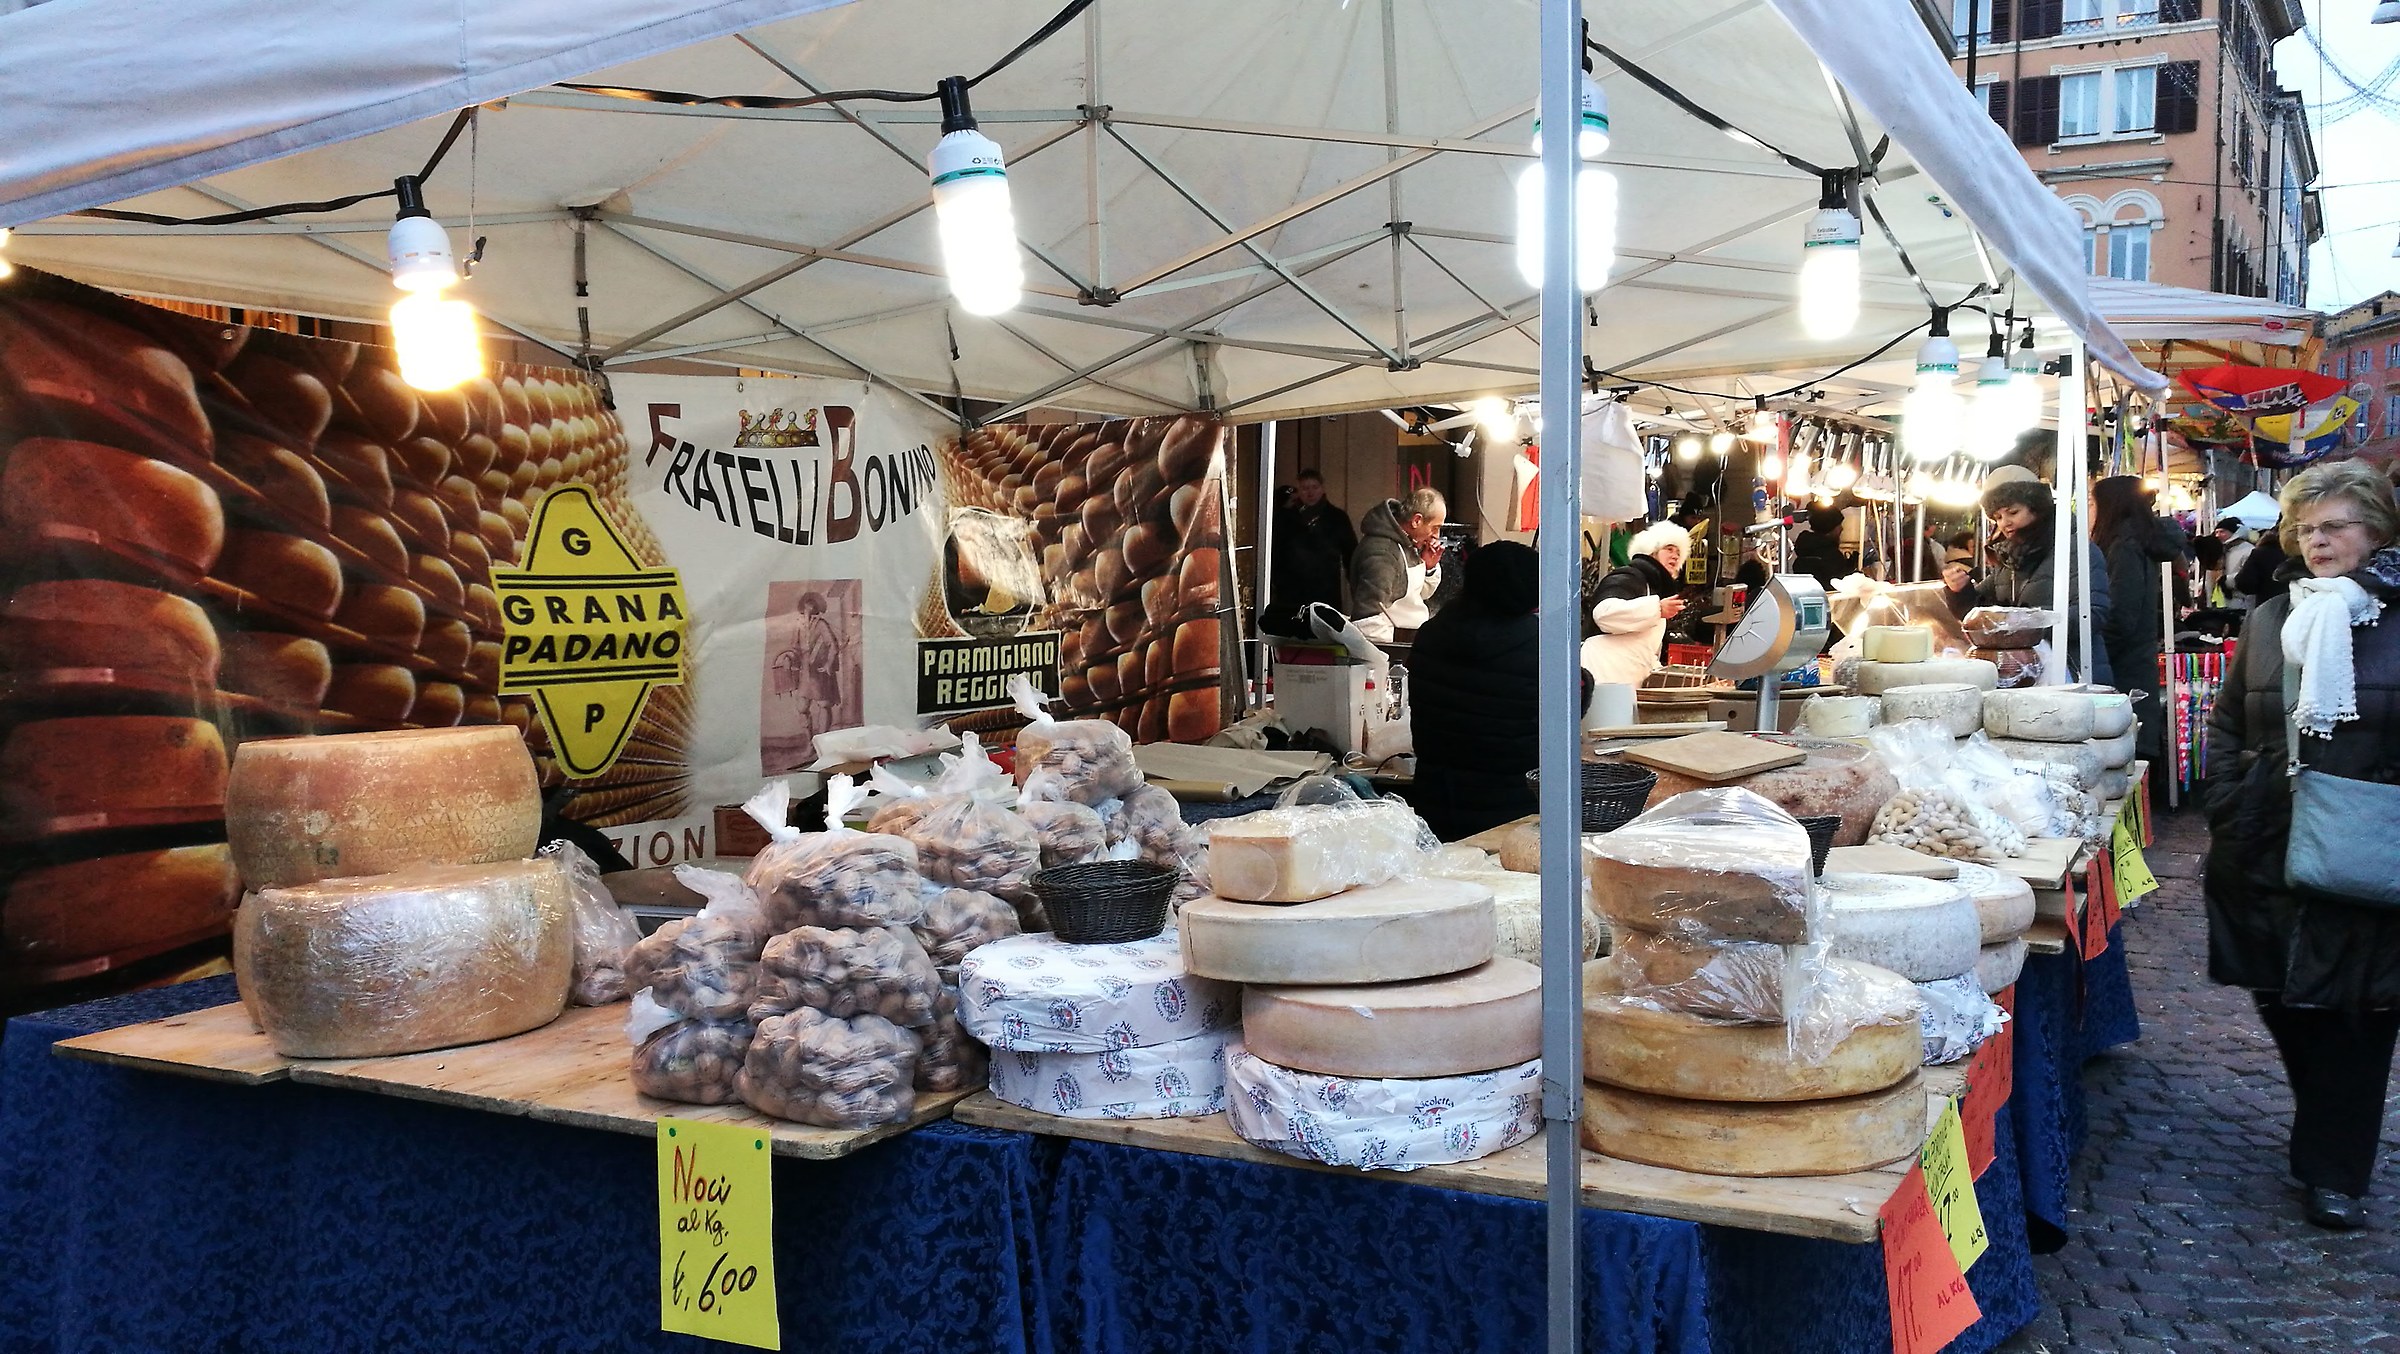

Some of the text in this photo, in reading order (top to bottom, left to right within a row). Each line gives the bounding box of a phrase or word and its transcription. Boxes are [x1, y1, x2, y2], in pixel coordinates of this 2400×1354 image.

[645, 403, 936, 546] FRATELLI BONINO
[561, 527, 591, 556] G
[502, 592, 684, 626] GRANA
[504, 630, 681, 664] PADANO
[924, 641, 1054, 676] PARMIGIANO
[937, 671, 1043, 705] REGGIO
[584, 703, 605, 733] P
[674, 1143, 732, 1204] Noci
[677, 1208, 700, 1233] al
